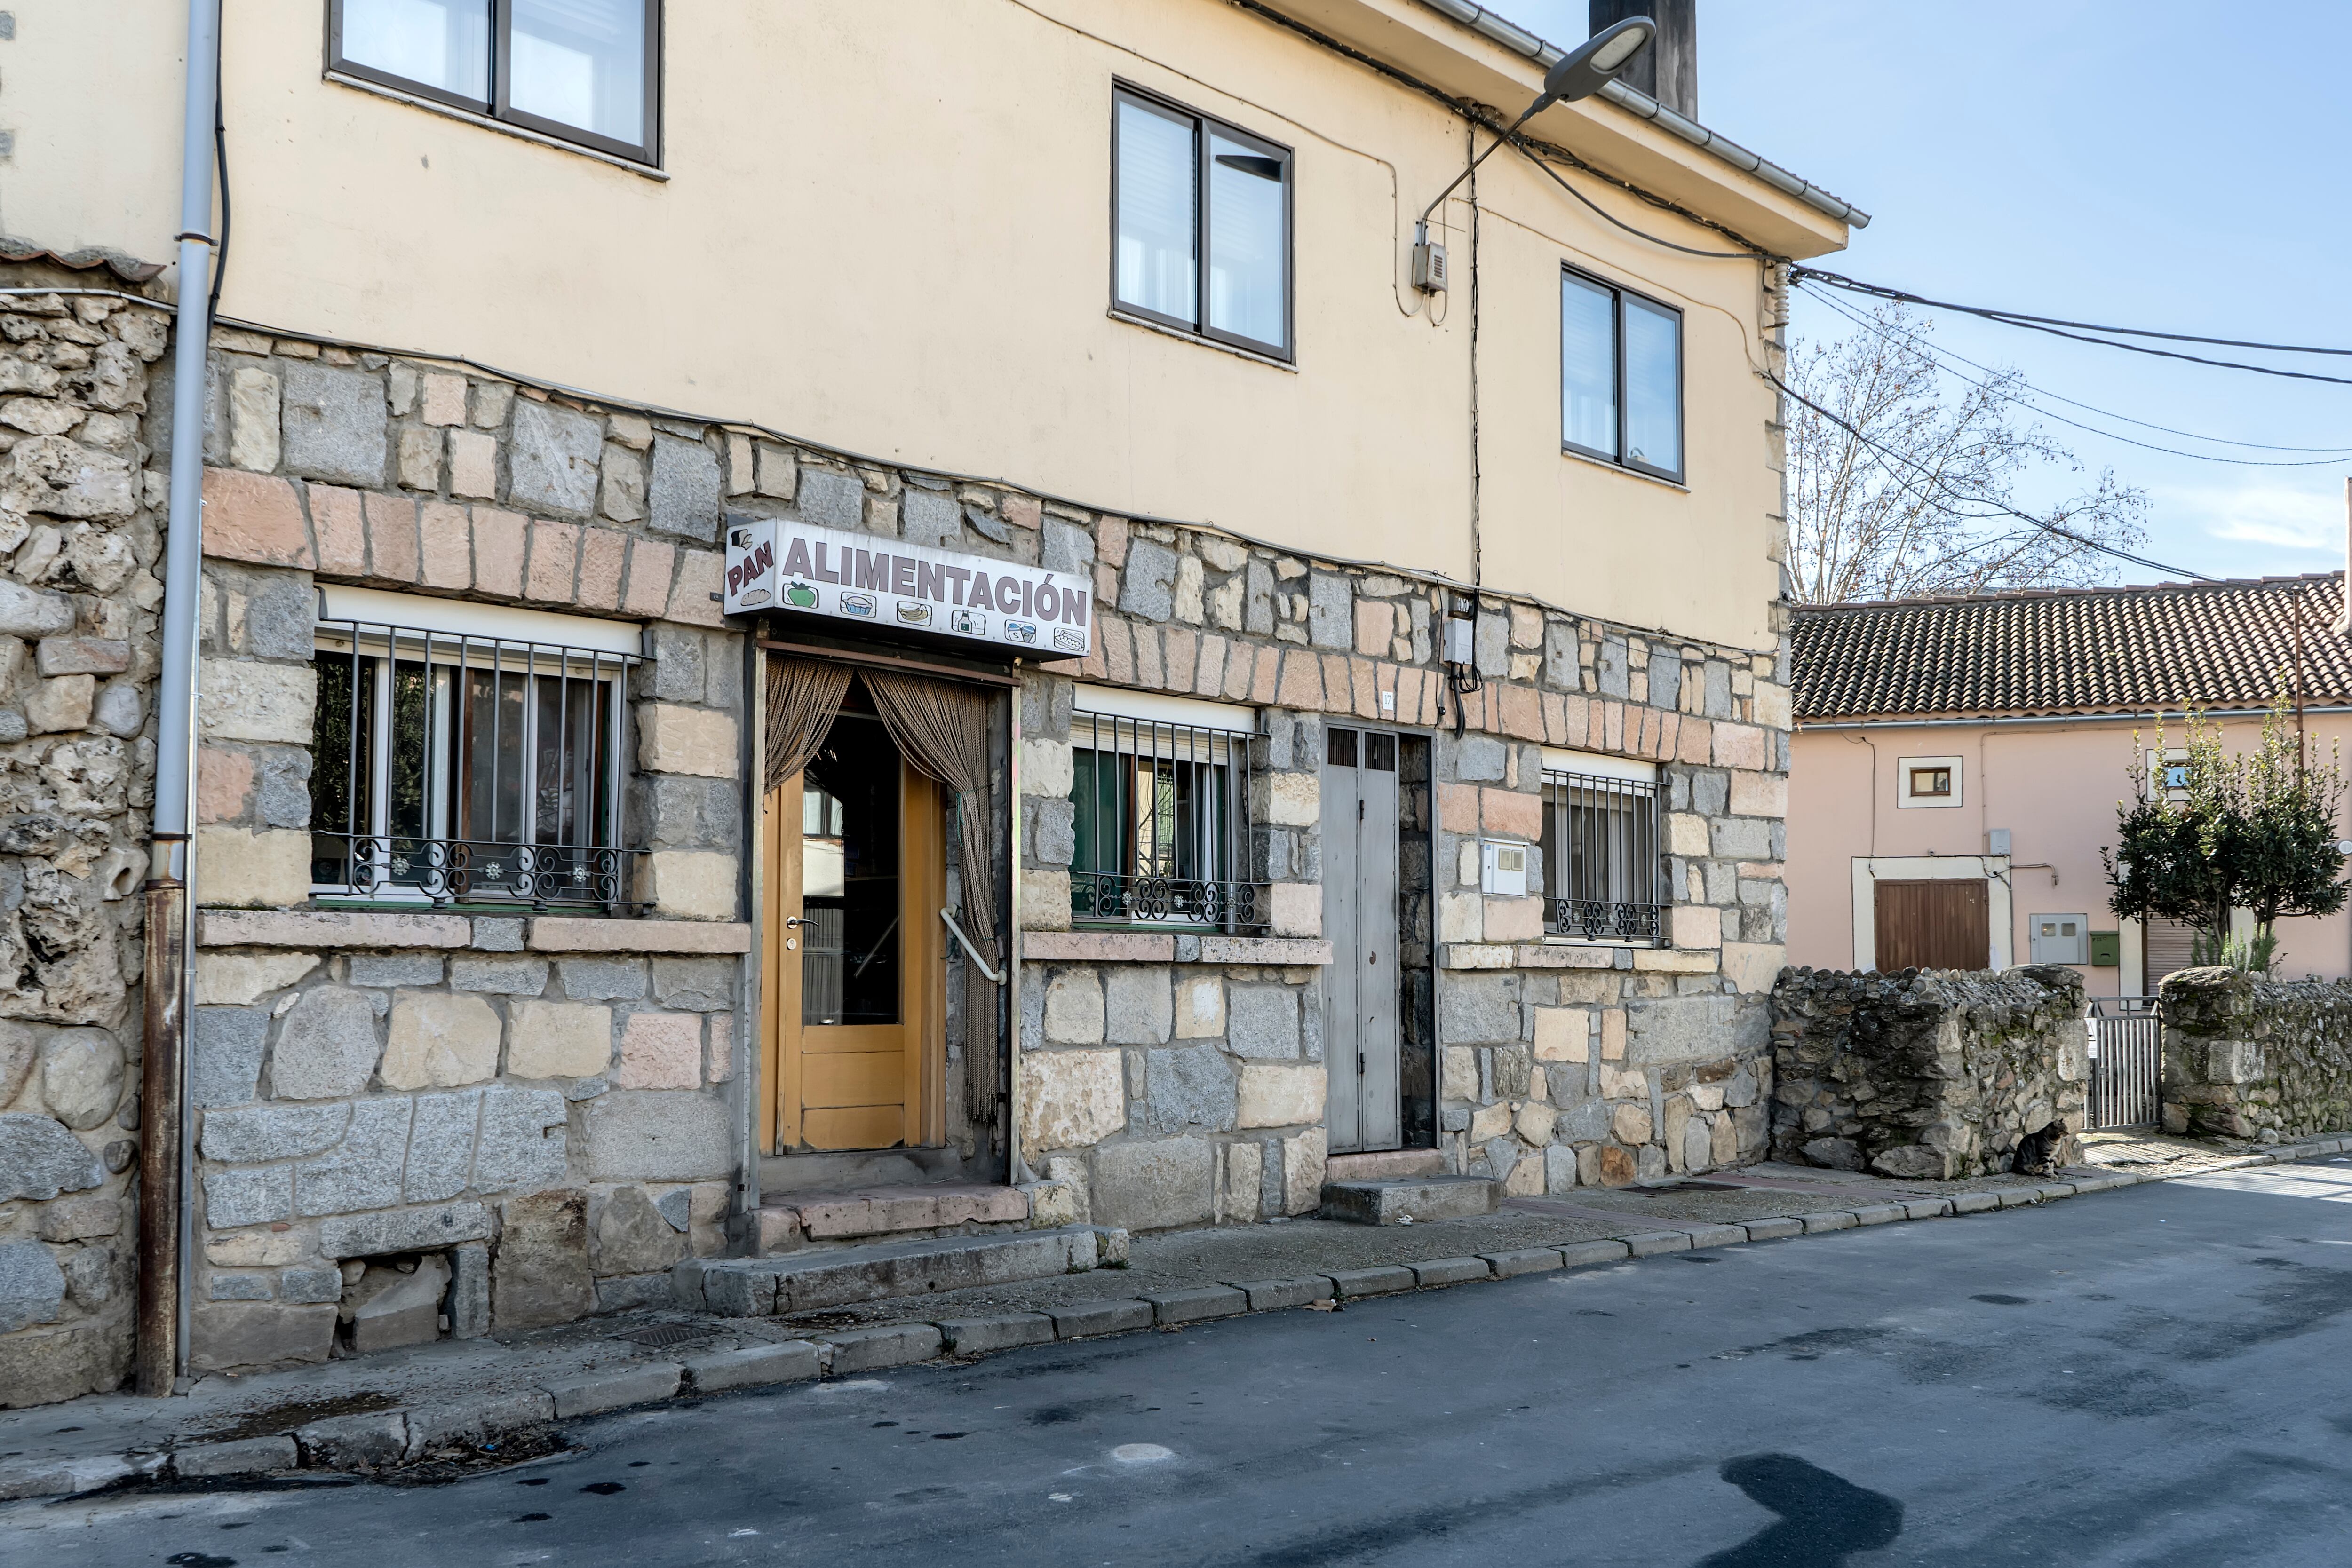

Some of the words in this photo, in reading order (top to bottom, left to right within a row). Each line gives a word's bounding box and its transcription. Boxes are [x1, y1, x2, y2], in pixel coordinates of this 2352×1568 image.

[727, 539, 774, 597] PAN
[782, 538, 1086, 626] ALIMENTACIÓN
[1385, 695, 1391, 705] 17
